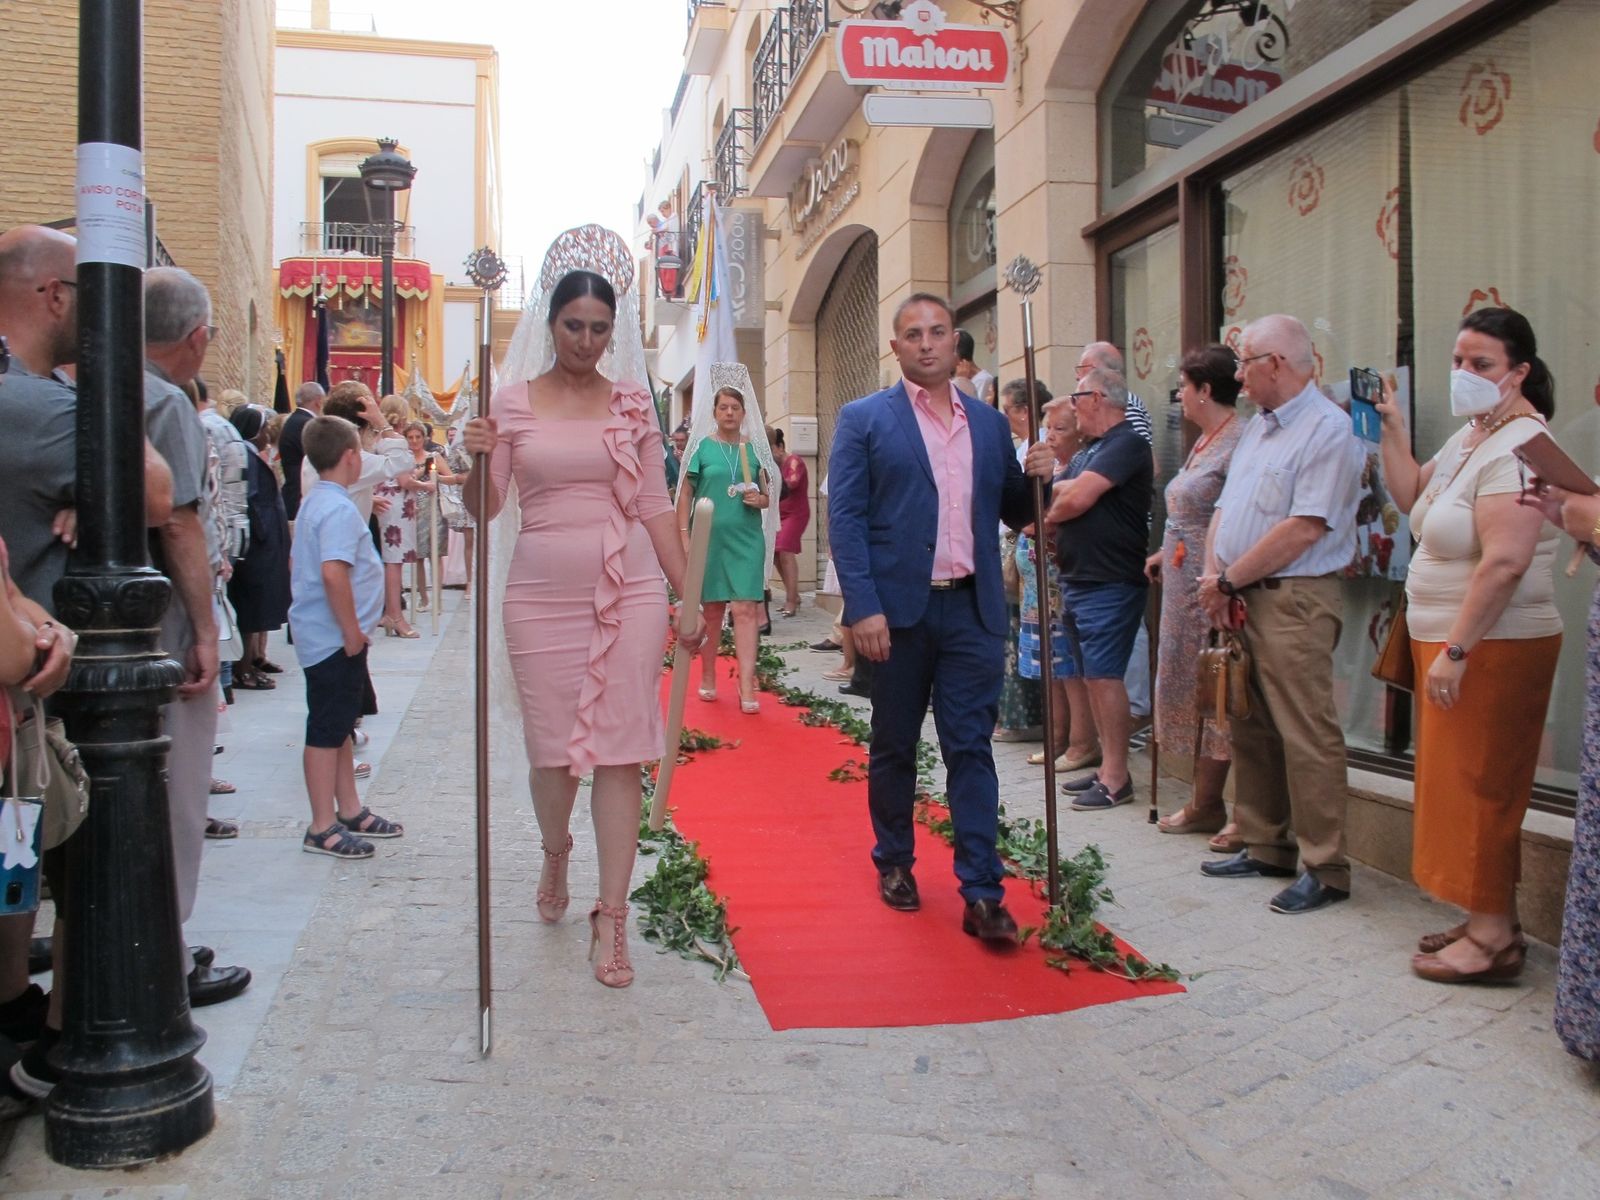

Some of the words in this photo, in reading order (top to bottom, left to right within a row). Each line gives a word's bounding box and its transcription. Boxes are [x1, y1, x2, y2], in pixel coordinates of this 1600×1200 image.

[859, 36, 995, 72] Mahou
[815, 138, 848, 202] 2000
[80, 185, 112, 195] AVISO
